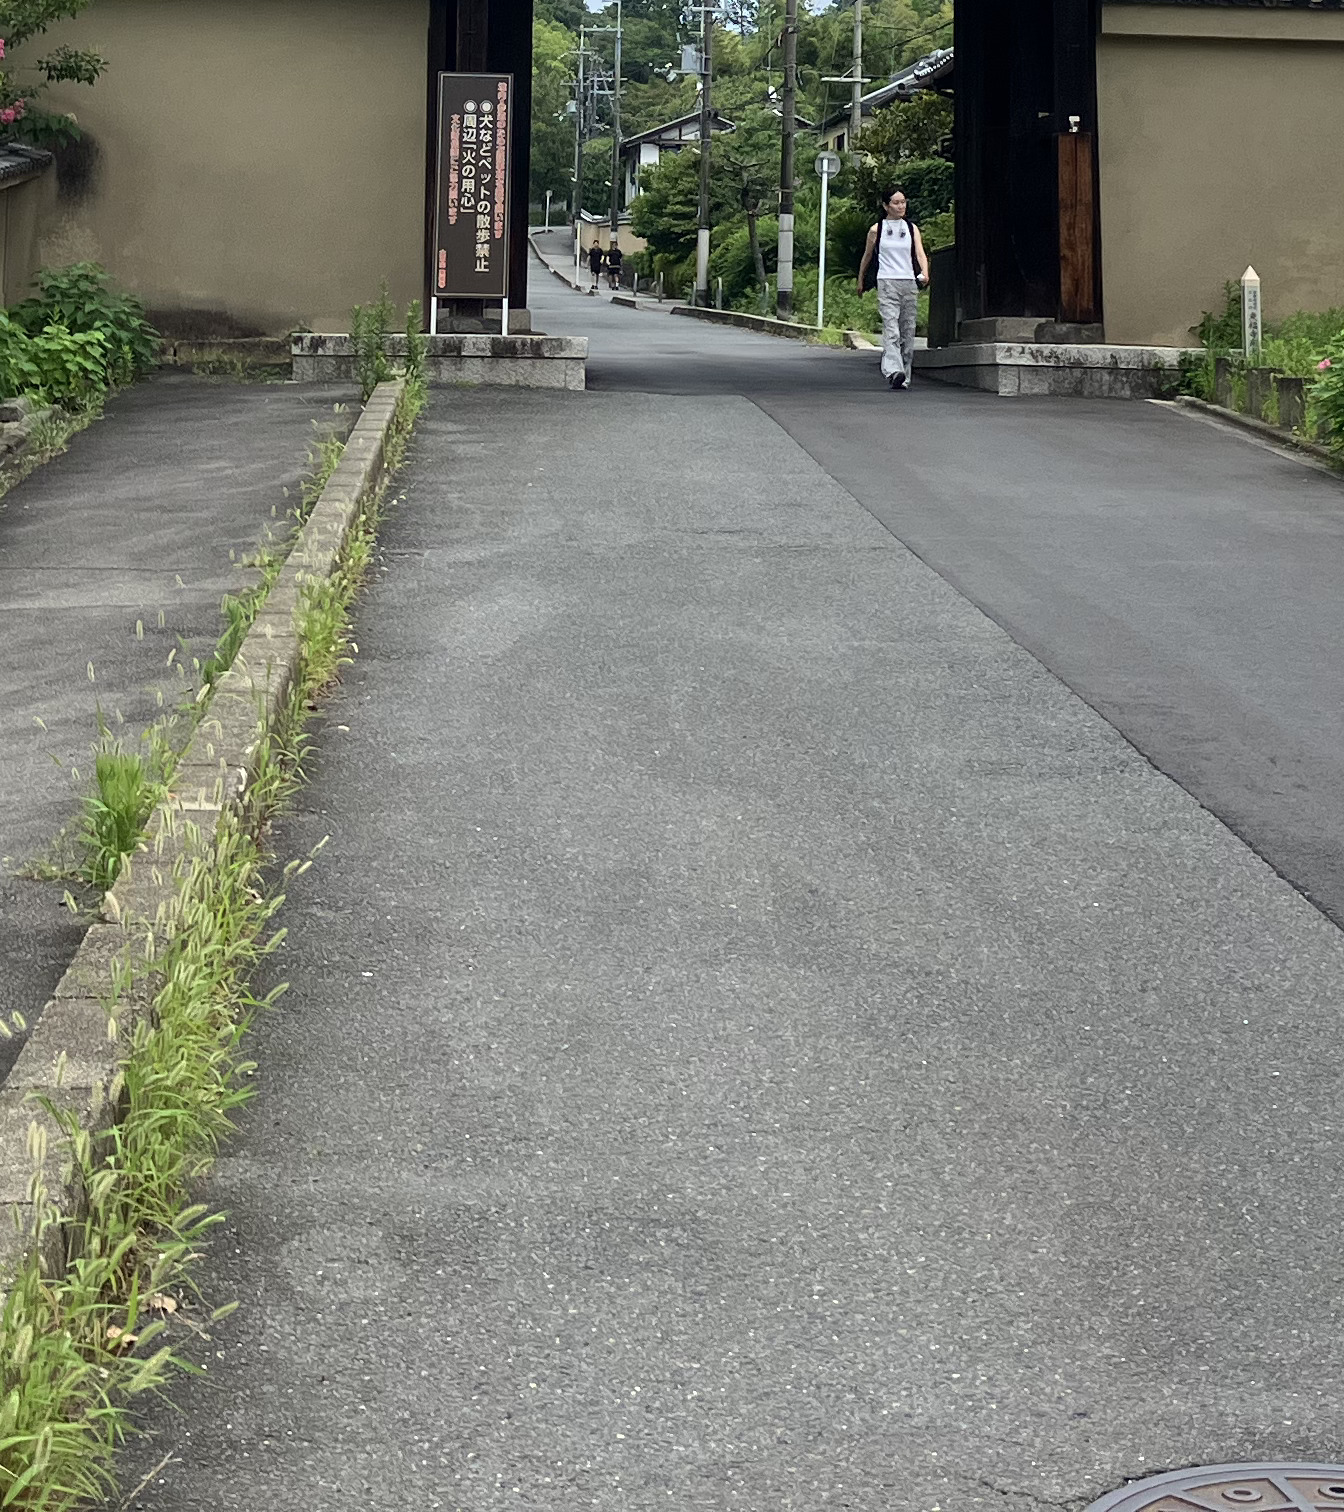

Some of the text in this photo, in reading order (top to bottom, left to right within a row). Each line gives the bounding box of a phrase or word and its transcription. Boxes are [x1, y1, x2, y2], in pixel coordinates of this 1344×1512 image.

[460, 113, 476, 213] 周辺「火の用心」
[474, 113, 493, 272] 犬などペットの散歩禁止
